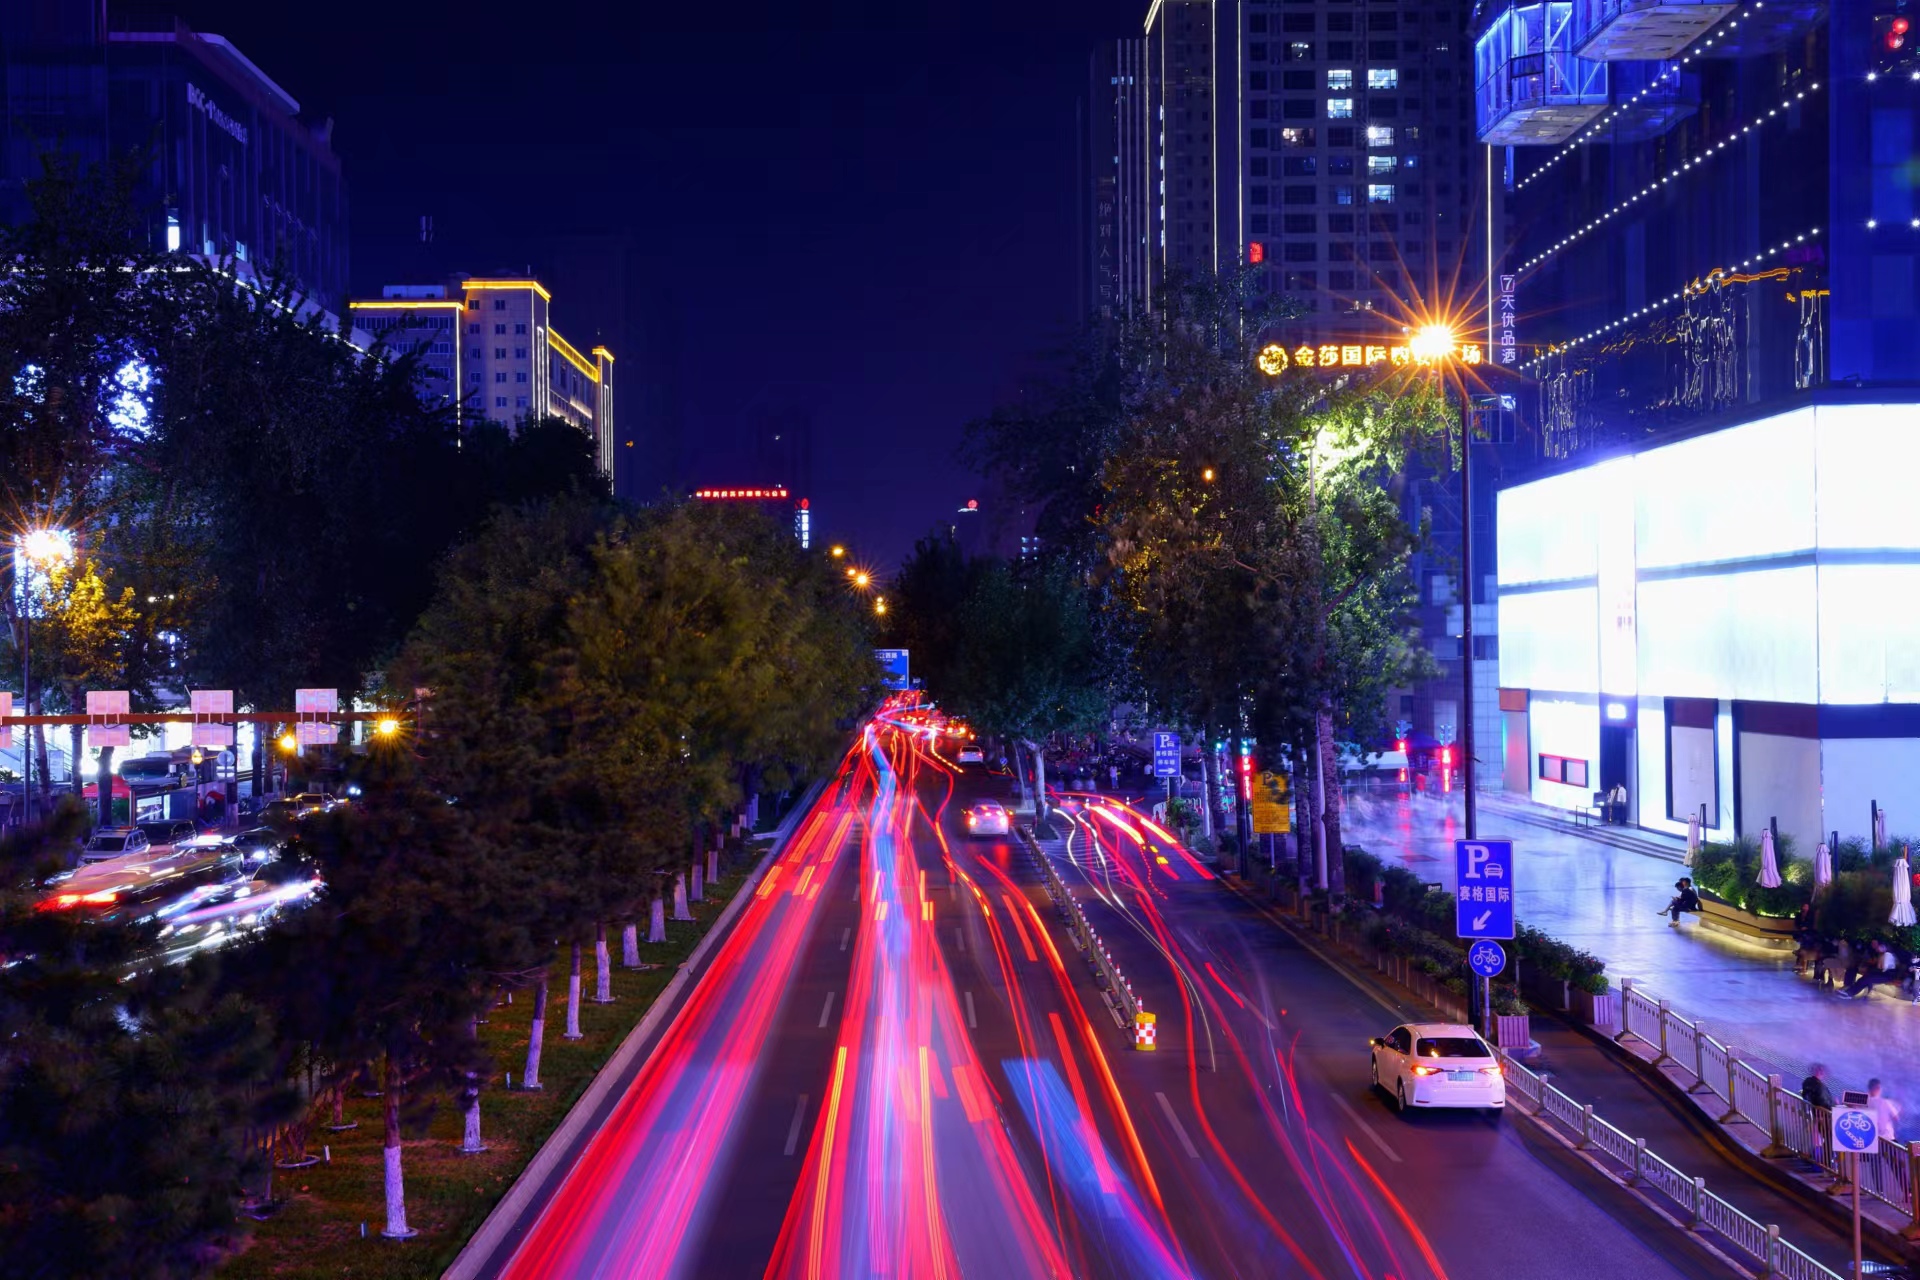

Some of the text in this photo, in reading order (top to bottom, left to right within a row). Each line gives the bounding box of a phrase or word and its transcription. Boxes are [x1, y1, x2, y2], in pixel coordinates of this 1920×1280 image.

[1160, 735, 1170, 748] P
[1464, 844, 1490, 879] P
[1459, 886, 1509, 903] 赛格国际
